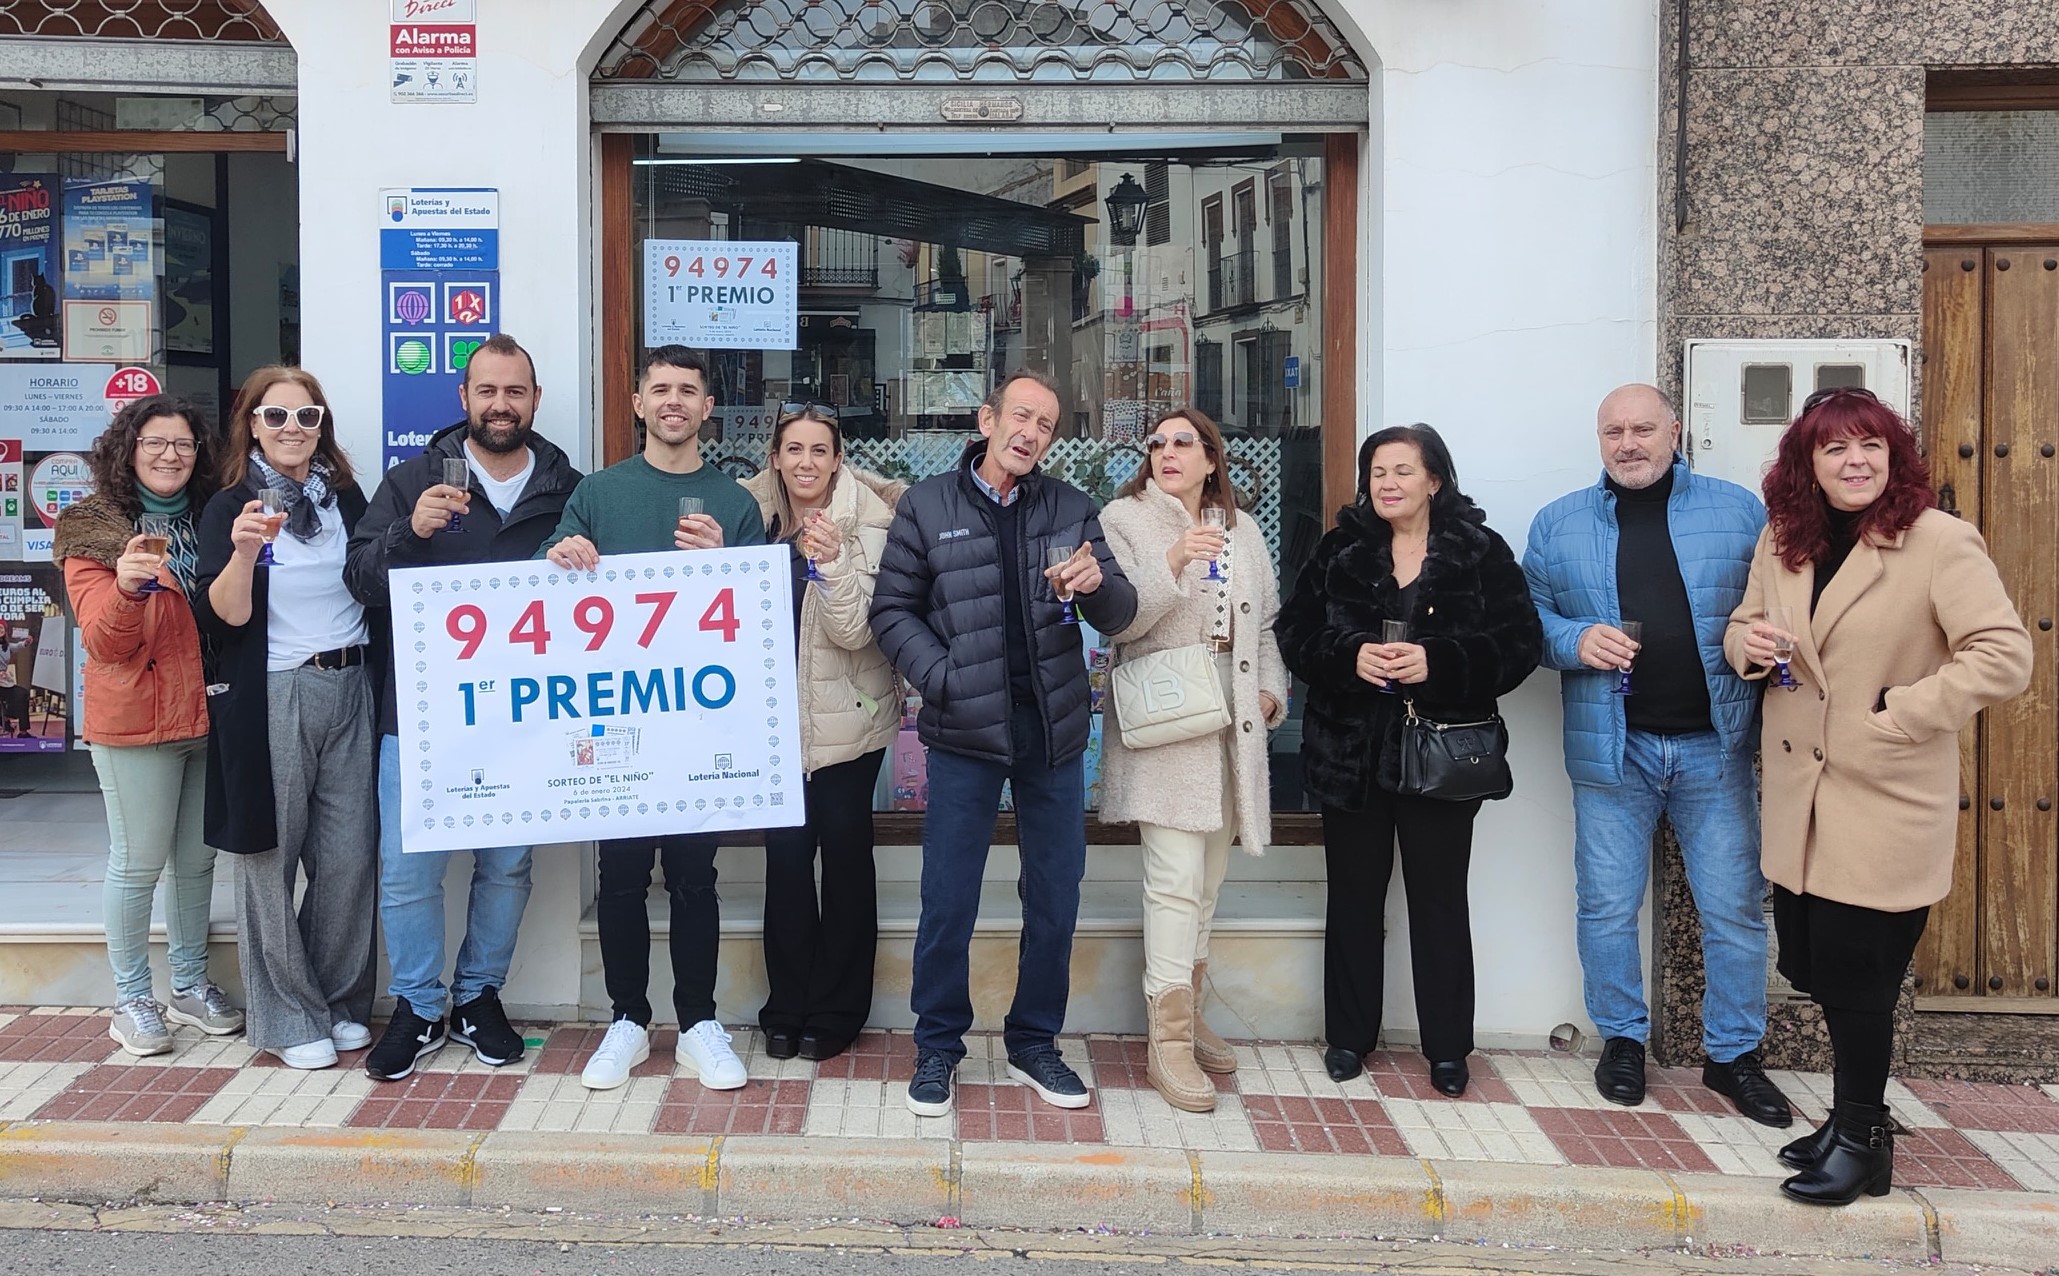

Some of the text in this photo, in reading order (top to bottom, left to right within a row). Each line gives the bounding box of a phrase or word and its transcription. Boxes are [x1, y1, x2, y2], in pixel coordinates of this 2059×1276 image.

[395, 28, 471, 44] Alarma
[412, 46, 435, 54] Aviso
[444, 46, 471, 54] Policía
[90, 186, 129, 195] TARJETAS
[8, 187, 50, 212] NIÑO
[82, 193, 137, 203] PLAYSTATION
[9, 212, 20, 222] DE
[22, 208, 50, 220] ENERO
[412, 208, 448, 216] Apuestas
[23, 226, 50, 235] MILLONES
[664, 255, 778, 280] 94974
[687, 285, 775, 305] PREMIO
[455, 294, 480, 311] 1 X
[29, 378, 78, 387] HORARIO
[115, 373, 148, 392] +18
[735, 416, 773, 428] 949
[388, 430, 438, 446] Loter
[748, 433, 772, 444] PRE
[939, 529, 969, 540] JOHN SMITH
[27, 541, 54, 550] VISA
[32, 588, 46, 596] AL
[3, 596, 51, 604] CUMPLIR
[10, 604, 23, 612] DE
[25, 604, 45, 612] SER
[445, 587, 740, 660] 94974
[510, 664, 737, 723] PREMIO
[547, 771, 653, 787] SORTEO DE "EL NIÑO"
[688, 769, 760, 782] Lotería Nacional
[446, 785, 473, 793] Loterías
[480, 783, 510, 791] Apuestas
[474, 791, 496, 799] Estado
